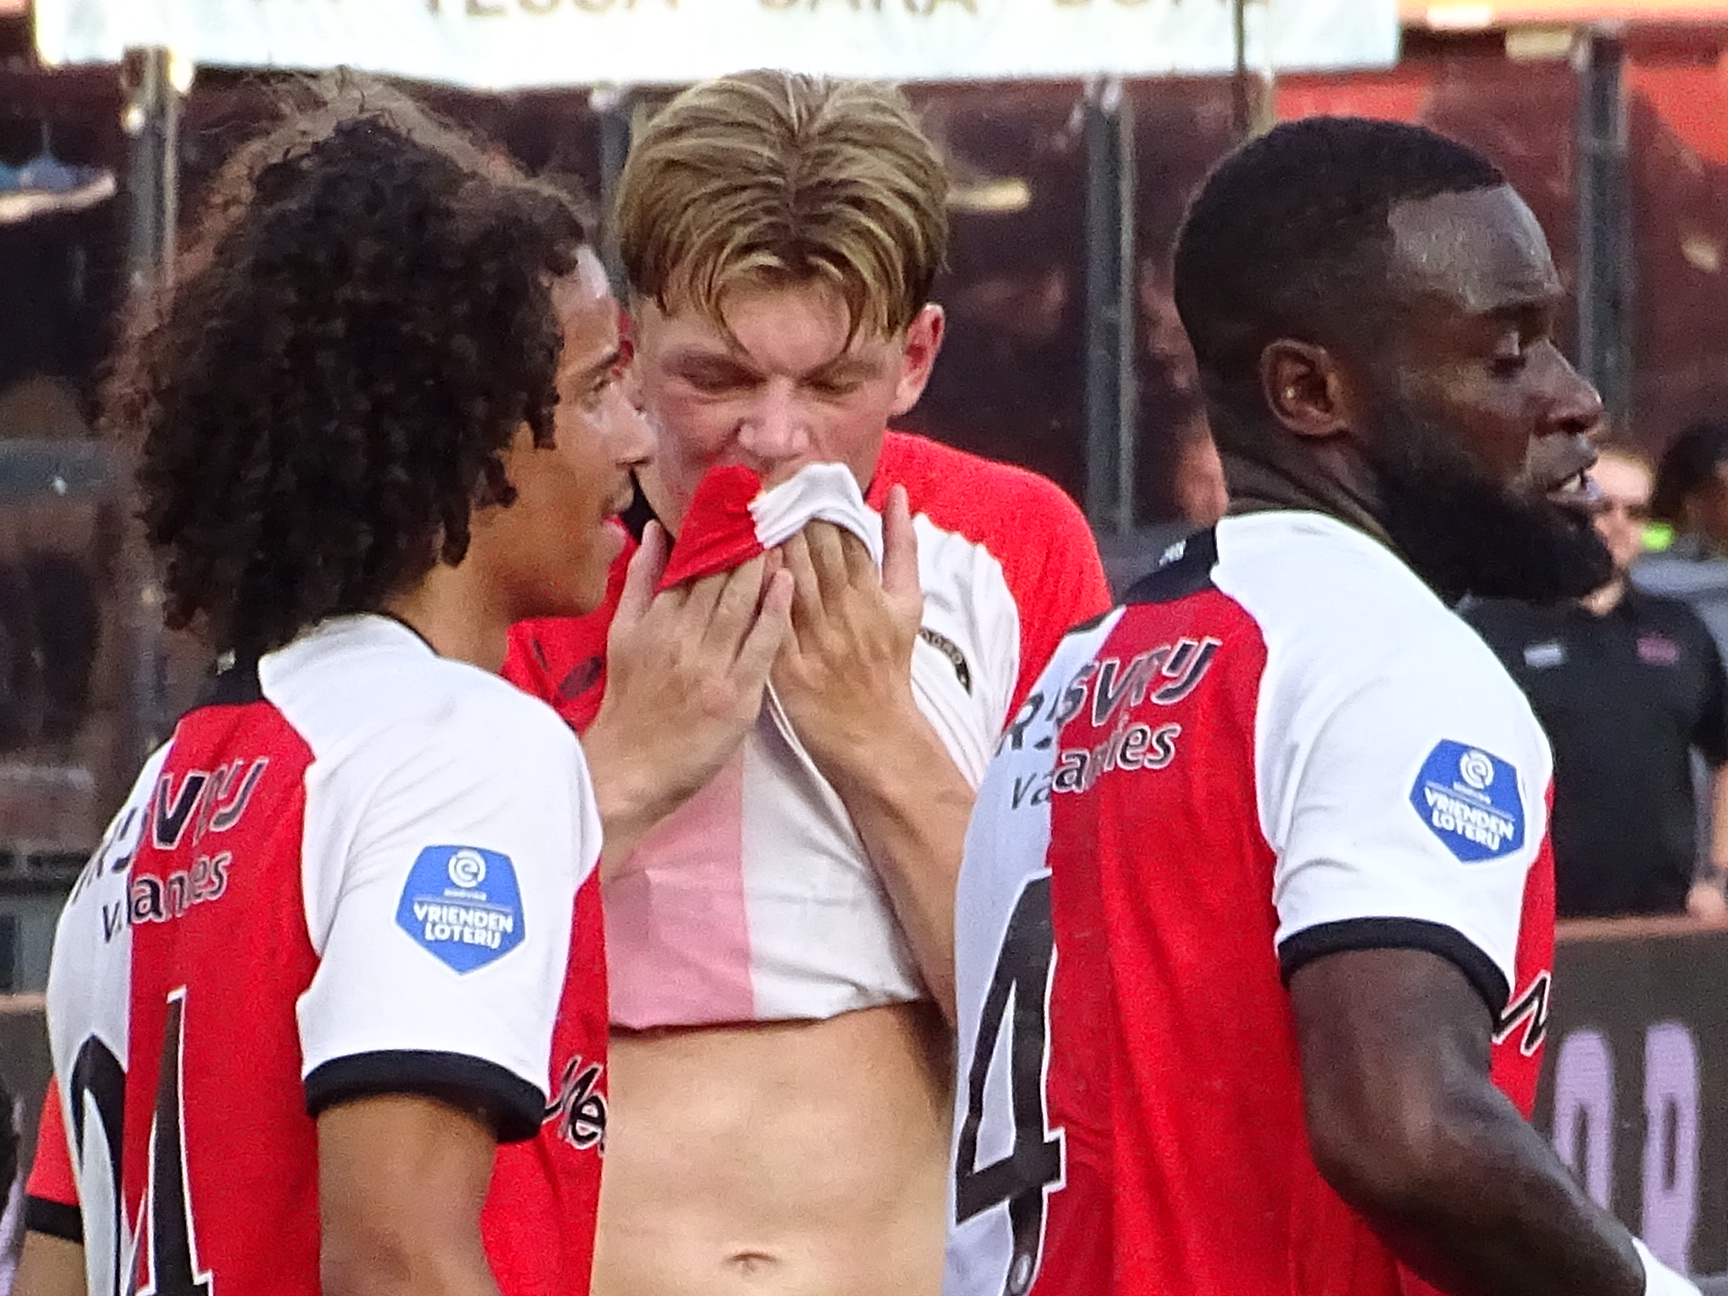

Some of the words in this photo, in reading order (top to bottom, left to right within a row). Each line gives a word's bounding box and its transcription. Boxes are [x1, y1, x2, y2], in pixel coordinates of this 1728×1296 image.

[1424, 786, 1514, 841] VRIENDEN
[413, 901, 513, 934] VRIENDEN
[425, 922, 501, 949] LOTERIJ
